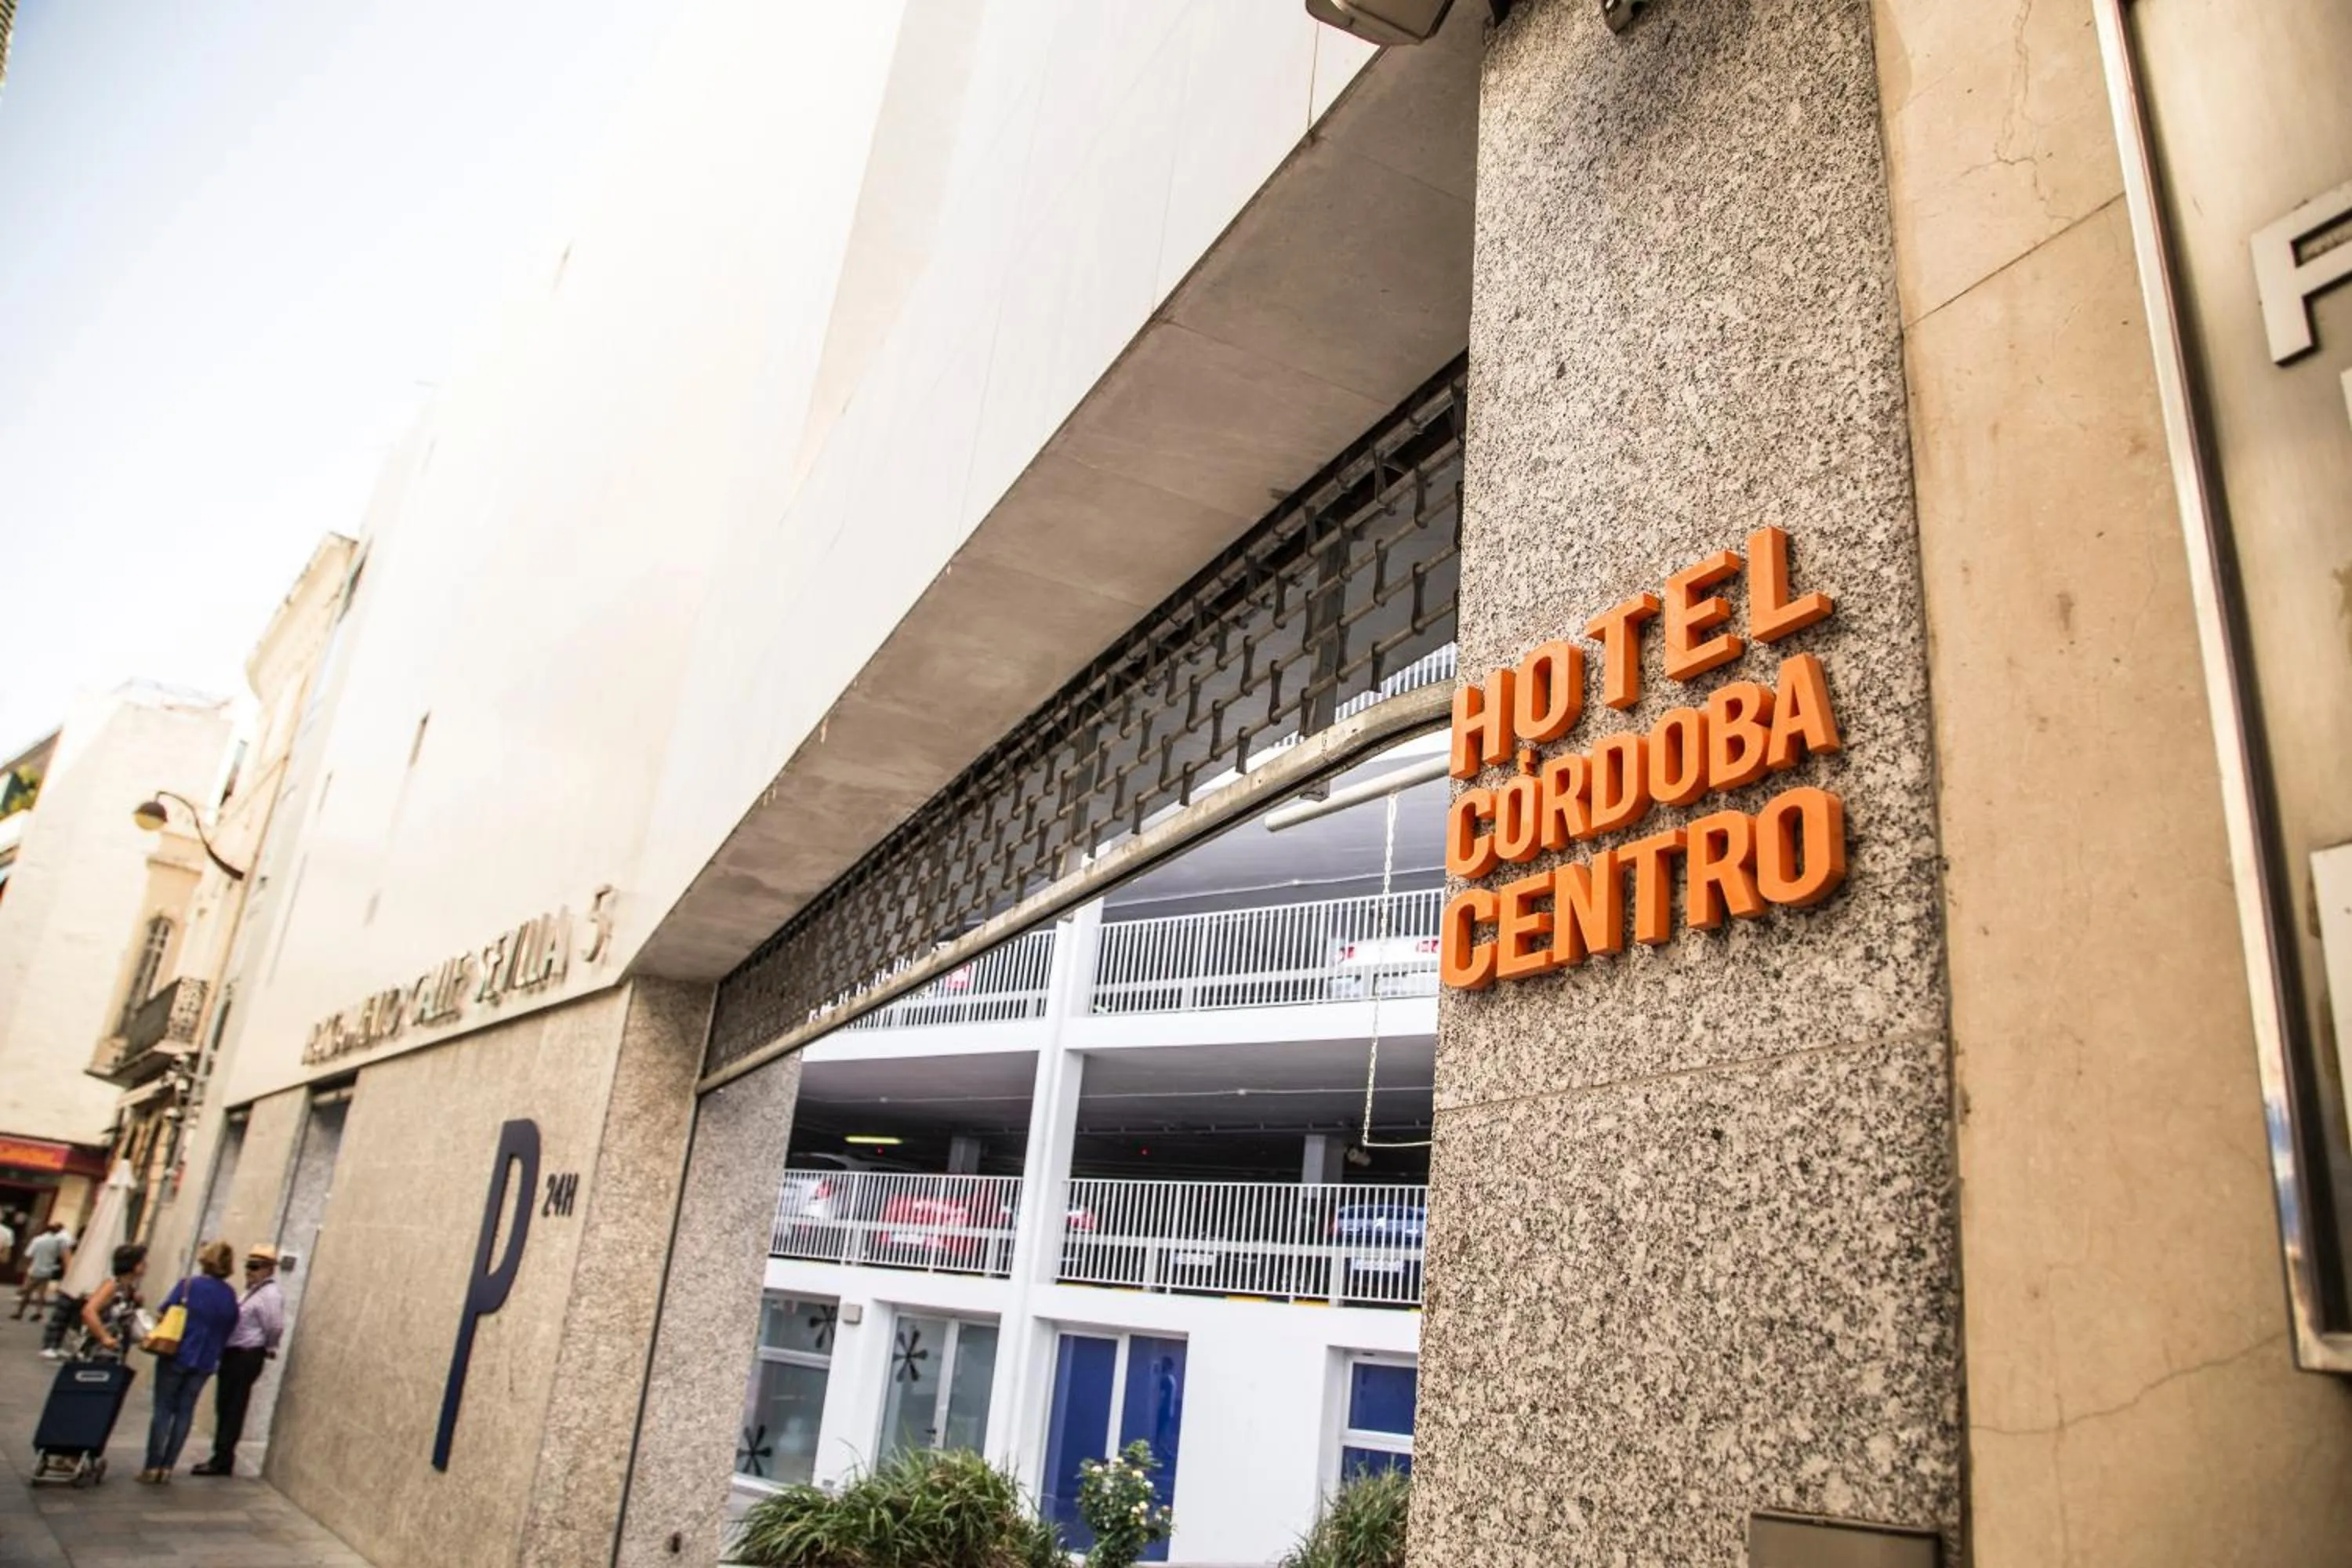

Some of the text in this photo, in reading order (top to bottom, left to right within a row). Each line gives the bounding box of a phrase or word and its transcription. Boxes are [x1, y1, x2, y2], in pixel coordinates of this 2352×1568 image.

[1446, 652, 1841, 880] CÓRDOBA
[1450, 526, 1833, 779] HOTEL
[1440, 786, 1846, 990] CENTRO
[432, 1118, 541, 1472] P
[541, 1173, 579, 1218] 24H
